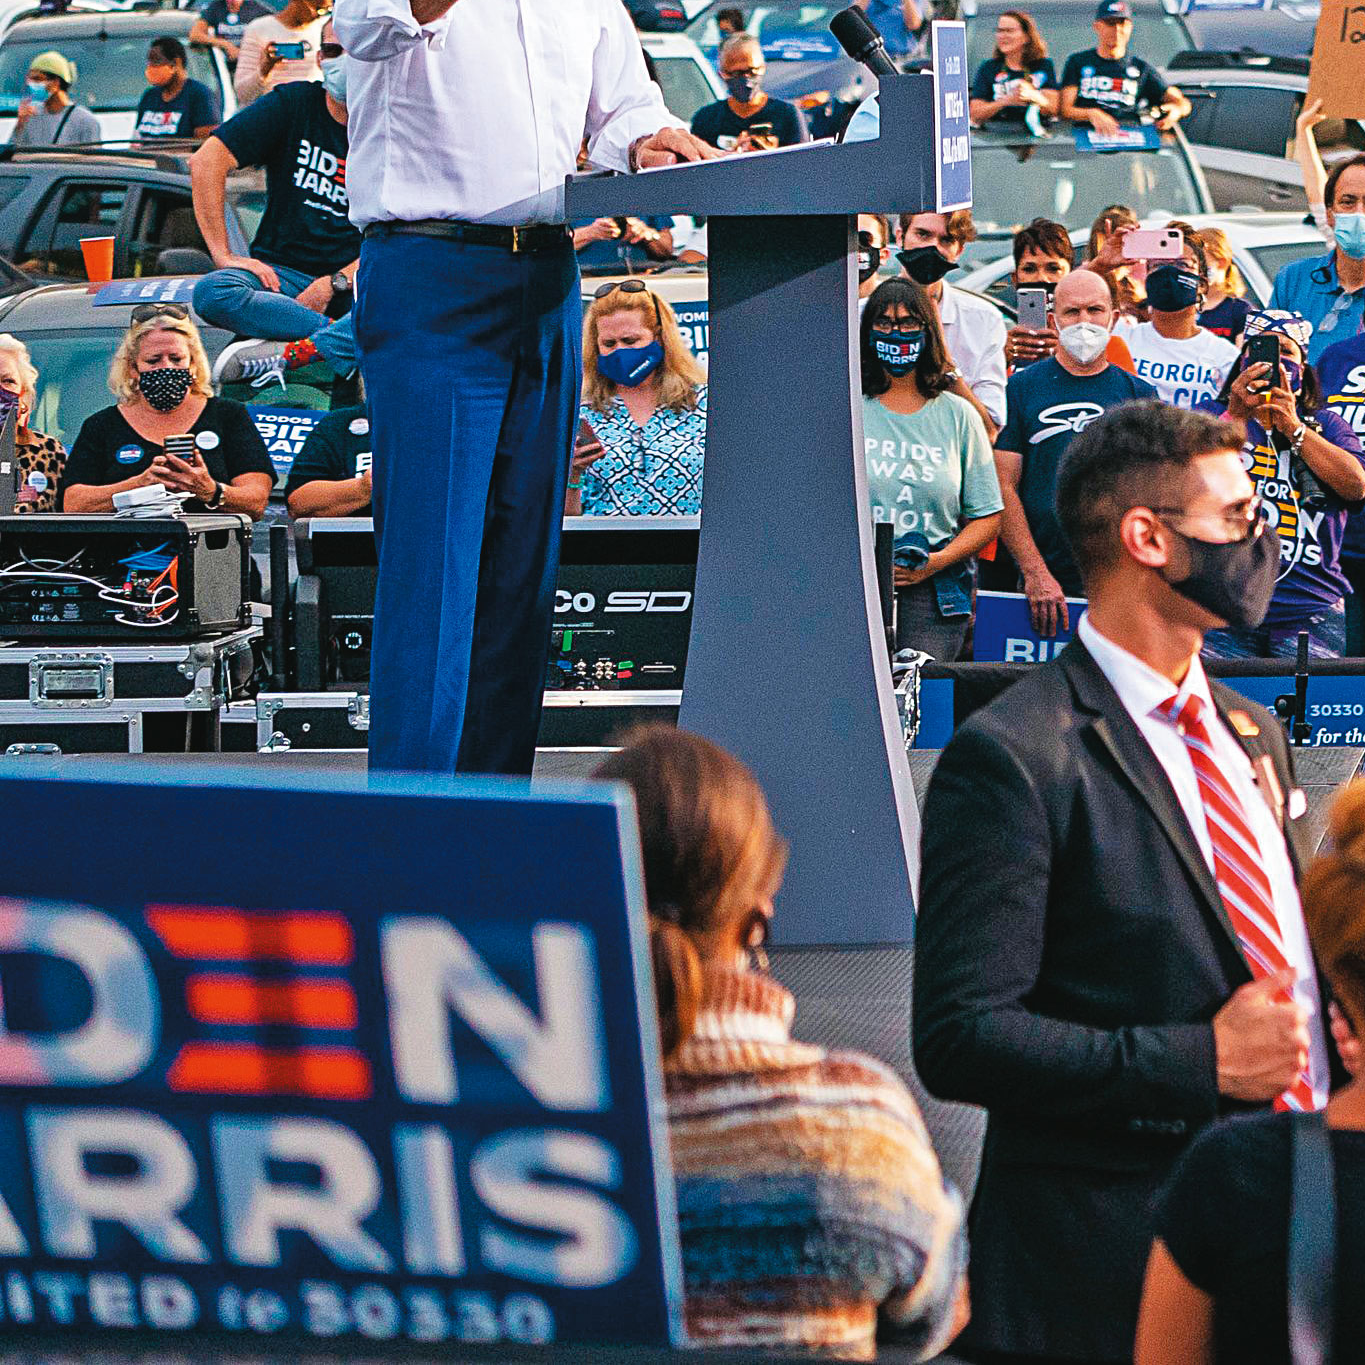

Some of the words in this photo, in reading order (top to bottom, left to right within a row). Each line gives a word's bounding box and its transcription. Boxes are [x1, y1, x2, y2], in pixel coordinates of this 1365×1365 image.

[875, 340, 920, 357] BIDEN
[876, 352, 919, 365] HARRIS
[256, 413, 312, 425] TODOS
[864, 437, 943, 464] PRIDE
[871, 459, 935, 483] WAS
[896, 484, 913, 505] A
[872, 505, 935, 531] RIOT
[604, 591, 692, 613] SD
[1310, 703, 1364, 716] 30330
[1313, 727, 1341, 747] for
[0, 896, 613, 1113] DEN
[0, 1105, 642, 1290] RRIS
[4, 1271, 198, 1331] ITED
[217, 1284, 290, 1335] to
[301, 1281, 558, 1346] 30330
